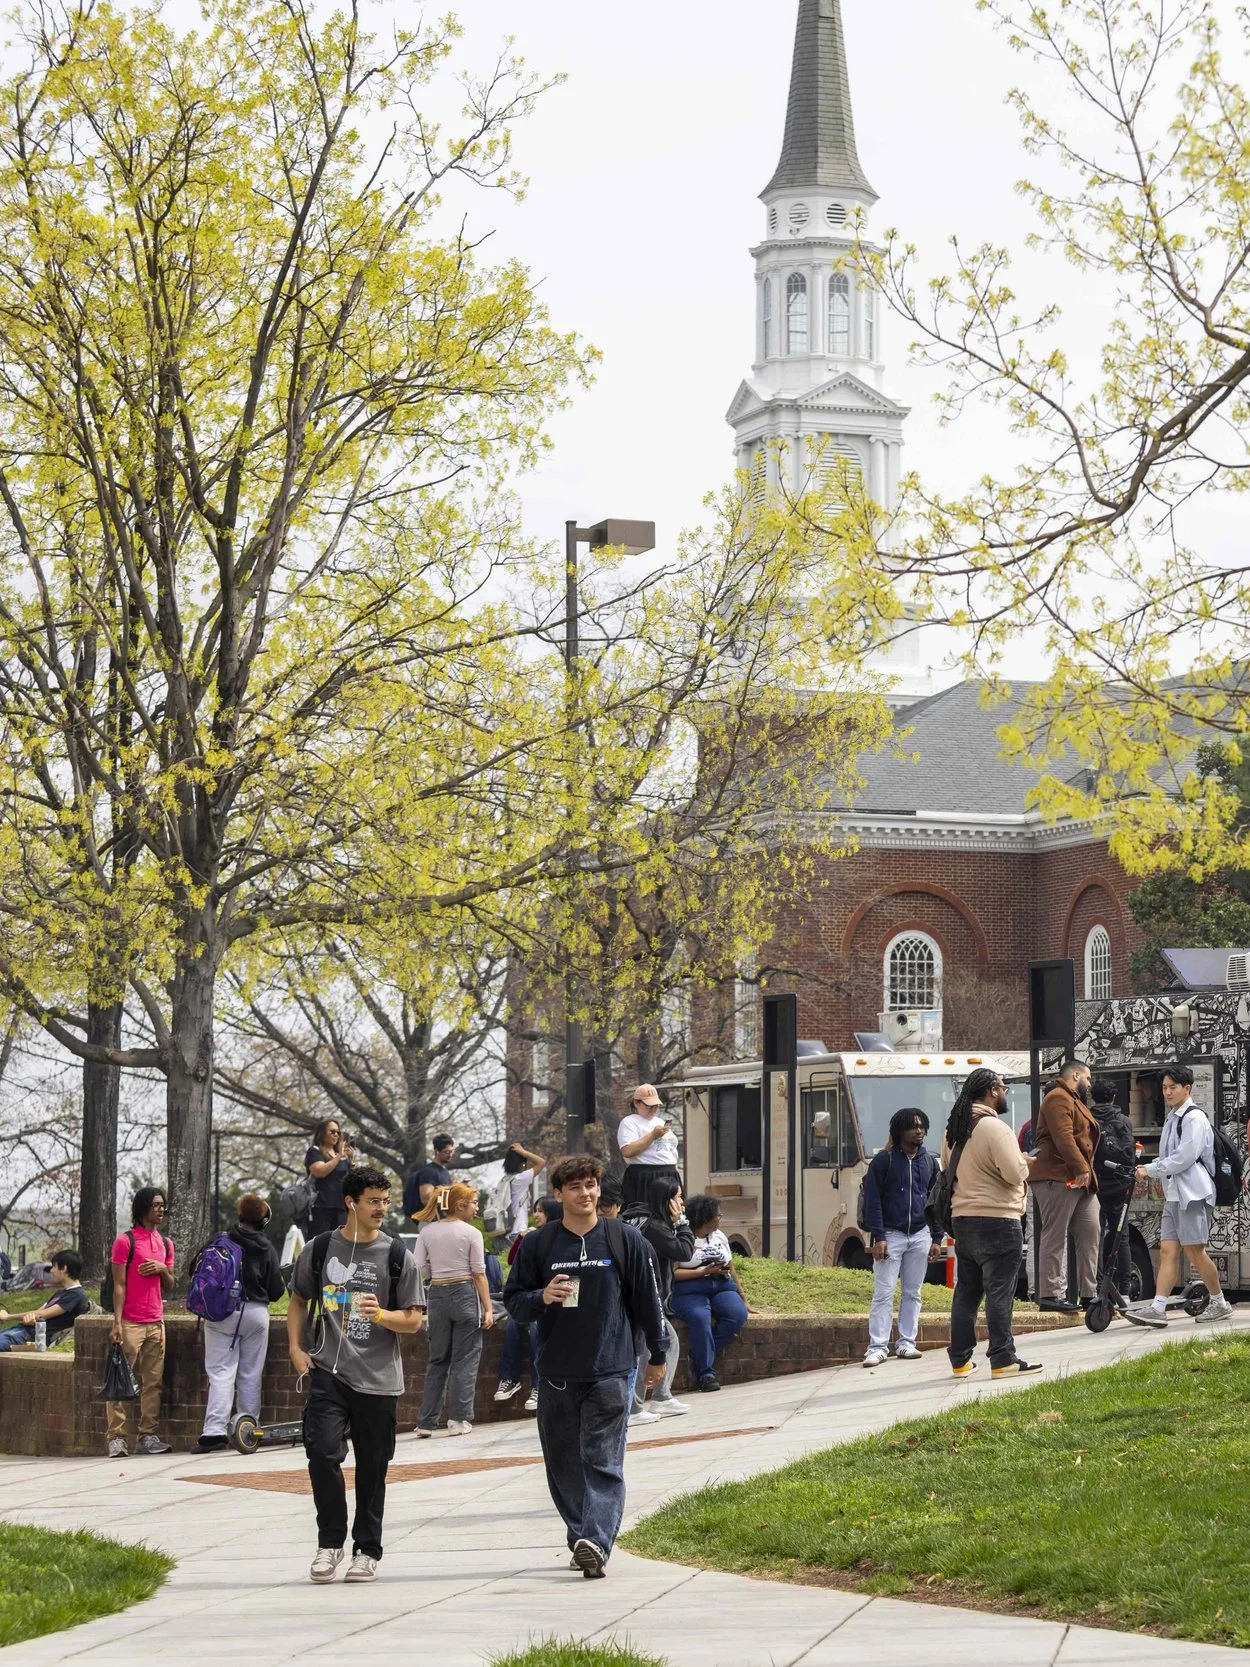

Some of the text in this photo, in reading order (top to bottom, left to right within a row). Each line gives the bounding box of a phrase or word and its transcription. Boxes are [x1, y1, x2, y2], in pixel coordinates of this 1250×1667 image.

[551, 1262, 579, 1270] OKEMO
[347, 1321, 371, 1332] PEACE
[347, 1331, 370, 1339] MUSIC
